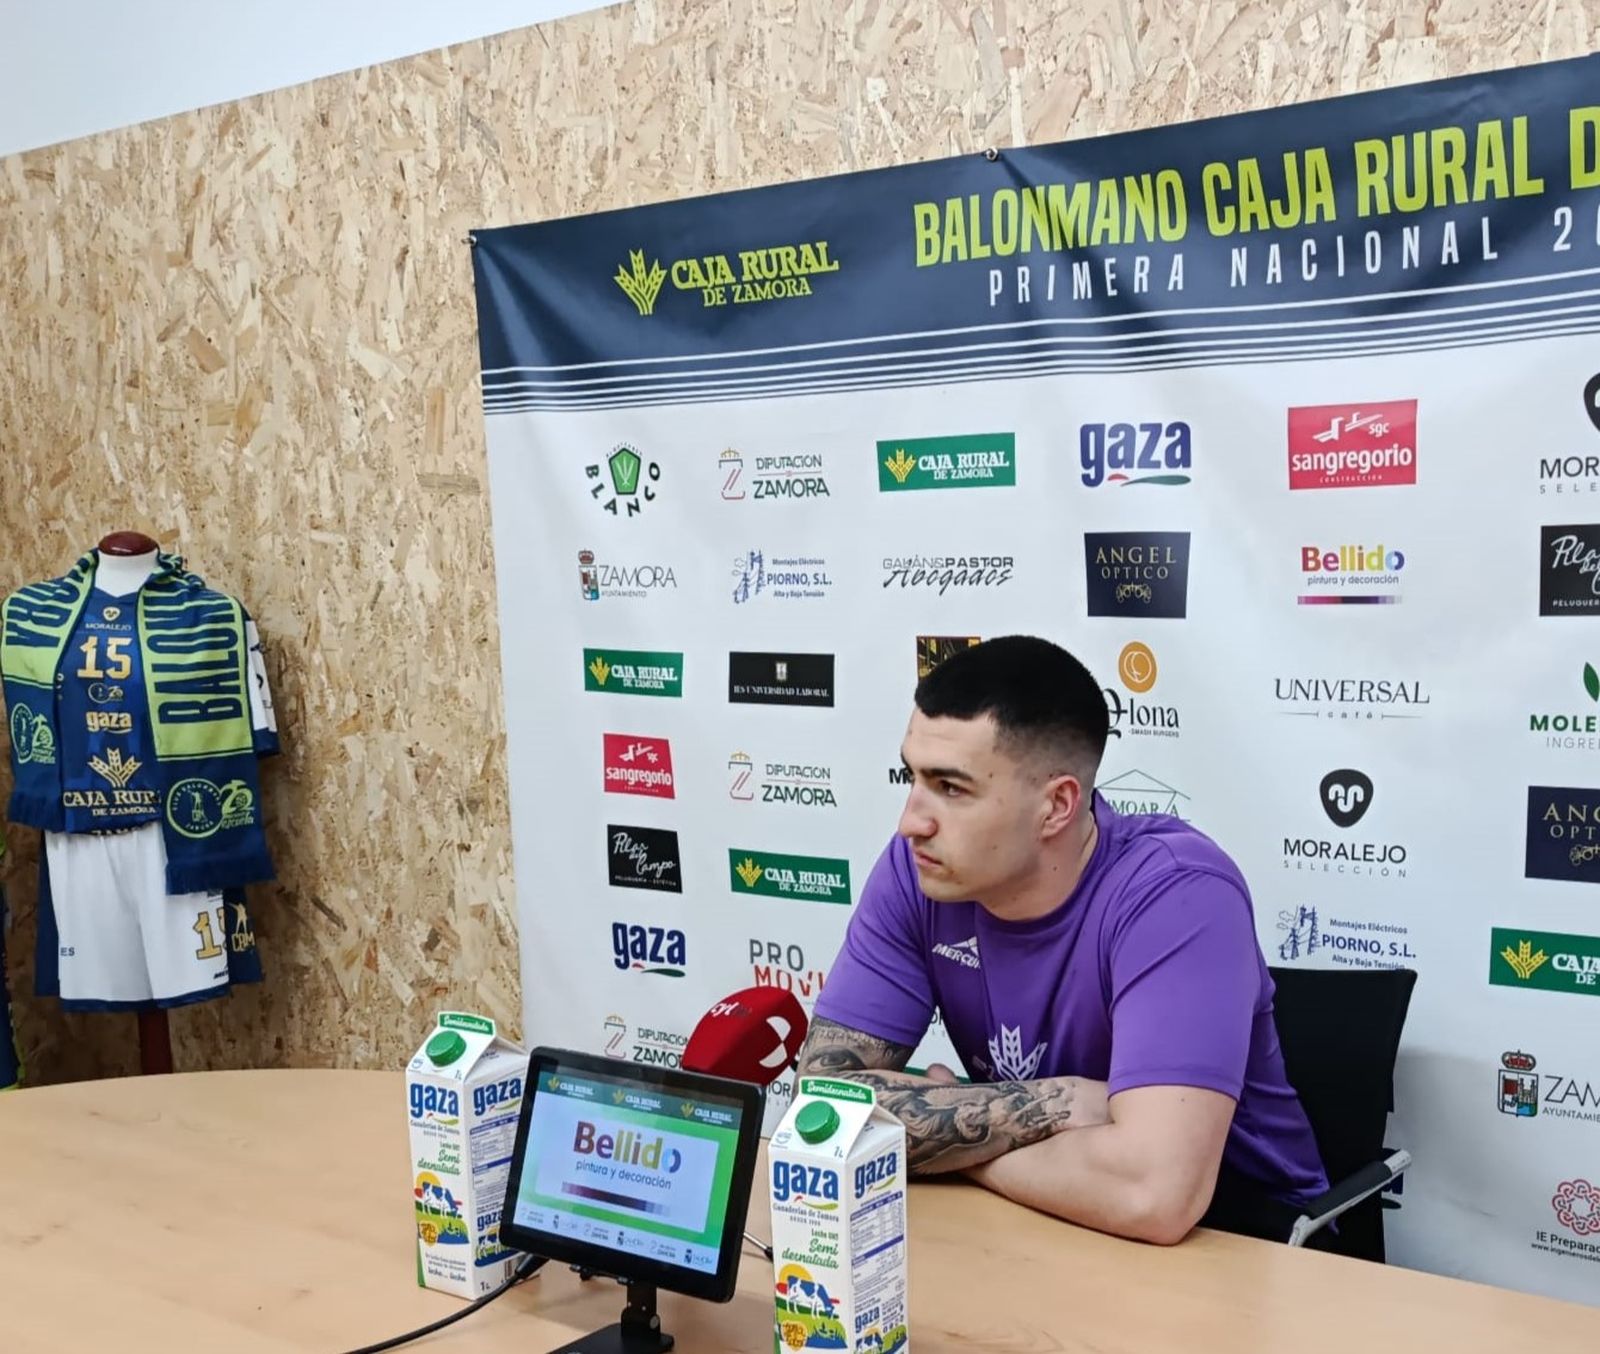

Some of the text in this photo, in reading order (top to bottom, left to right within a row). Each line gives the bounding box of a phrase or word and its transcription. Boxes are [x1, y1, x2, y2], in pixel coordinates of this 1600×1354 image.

[914, 169, 1188, 267] BALONMANO
[1202, 148, 1336, 237] CAJA
[1354, 116, 1544, 217] RURAL
[671, 241, 839, 289] CAJA RURAL
[989, 206, 1600, 306] PRIMERA NACIONAL 2
[703, 281, 812, 307] DE ZAMORA
[1368, 422, 1390, 438] sgc
[918, 451, 1009, 471] CAJA RURAL
[1080, 422, 1191, 487] gaza
[1292, 443, 1413, 475] sangregorio
[934, 468, 993, 480] DE ZAMORA
[1540, 456, 1600, 479] MOR
[753, 478, 830, 499] ZAMORA
[1095, 547, 1177, 564] ANGEL
[1302, 545, 1404, 572] Bellido
[599, 565, 677, 588] ZAMORA
[767, 573, 832, 587] PIORNO, S.L.
[1307, 575, 1399, 586] pintura y decoración
[85, 623, 131, 631] MORALEJO
[77, 635, 132, 679] 15
[611, 665, 678, 681] CAJA RURAL
[623, 678, 665, 689] DE ZAMORA
[746, 686, 795, 695] UNIVERSIDAD
[796, 687, 829, 697] LABORAL
[1275, 678, 1430, 704] UNIVERSAL
[86, 711, 132, 732] gaza
[606, 768, 672, 787] sangregorio
[63, 790, 109, 807] CAJA
[761, 785, 837, 807] ZAMORA
[92, 806, 156, 816] DE ZAMORA
[1284, 838, 1406, 864] MORALEJO
[764, 868, 846, 889] CAJA RURAL
[1284, 860, 1406, 877] SELECCIÓN
[778, 882, 832, 896] DE ZAMORA
[1330, 919, 1407, 934] Montajes Eléctricos
[612, 922, 686, 970] gaza
[750, 938, 804, 972] PRO
[1322, 934, 1416, 958] PIORNO, S.L.
[1332, 954, 1347, 963] Alta
[1355, 957, 1372, 968] Baja
[1576, 973, 1596, 985] DE
[410, 1083, 459, 1118] gaza
[473, 1078, 521, 1116] gaza
[573, 1120, 682, 1174] Bellido
[575, 1159, 671, 1190] pintura y decoración
[773, 1161, 839, 1202] gaza
[855, 1152, 897, 1199] gaza
[809, 1238, 838, 1256] Semi
[1536, 1231, 1547, 1242] IE
[855, 1306, 880, 1333] gaza
